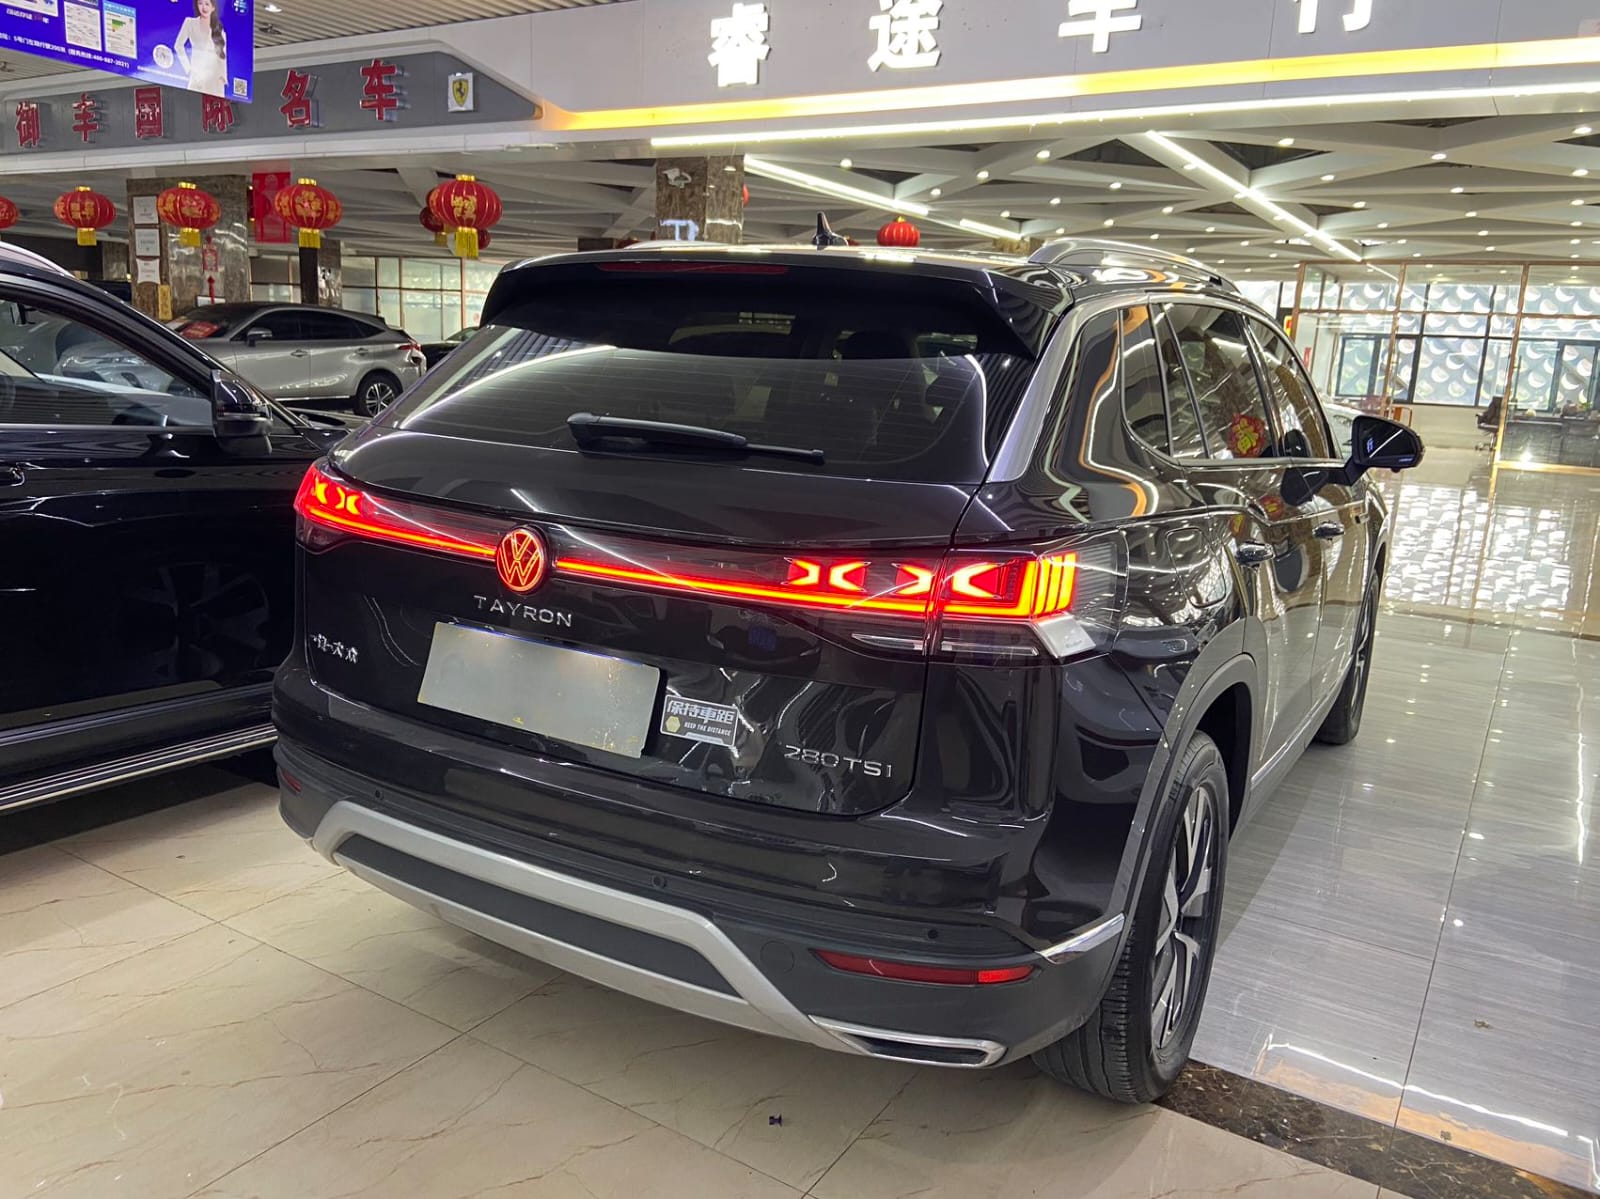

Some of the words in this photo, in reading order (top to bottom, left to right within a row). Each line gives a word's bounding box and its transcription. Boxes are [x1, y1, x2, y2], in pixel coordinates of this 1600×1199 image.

[473, 595, 572, 627] TAYRON
[684, 721, 697, 729] KEEP
[707, 726, 732, 737] DISTANCE
[784, 744, 892, 778] 280TSI
